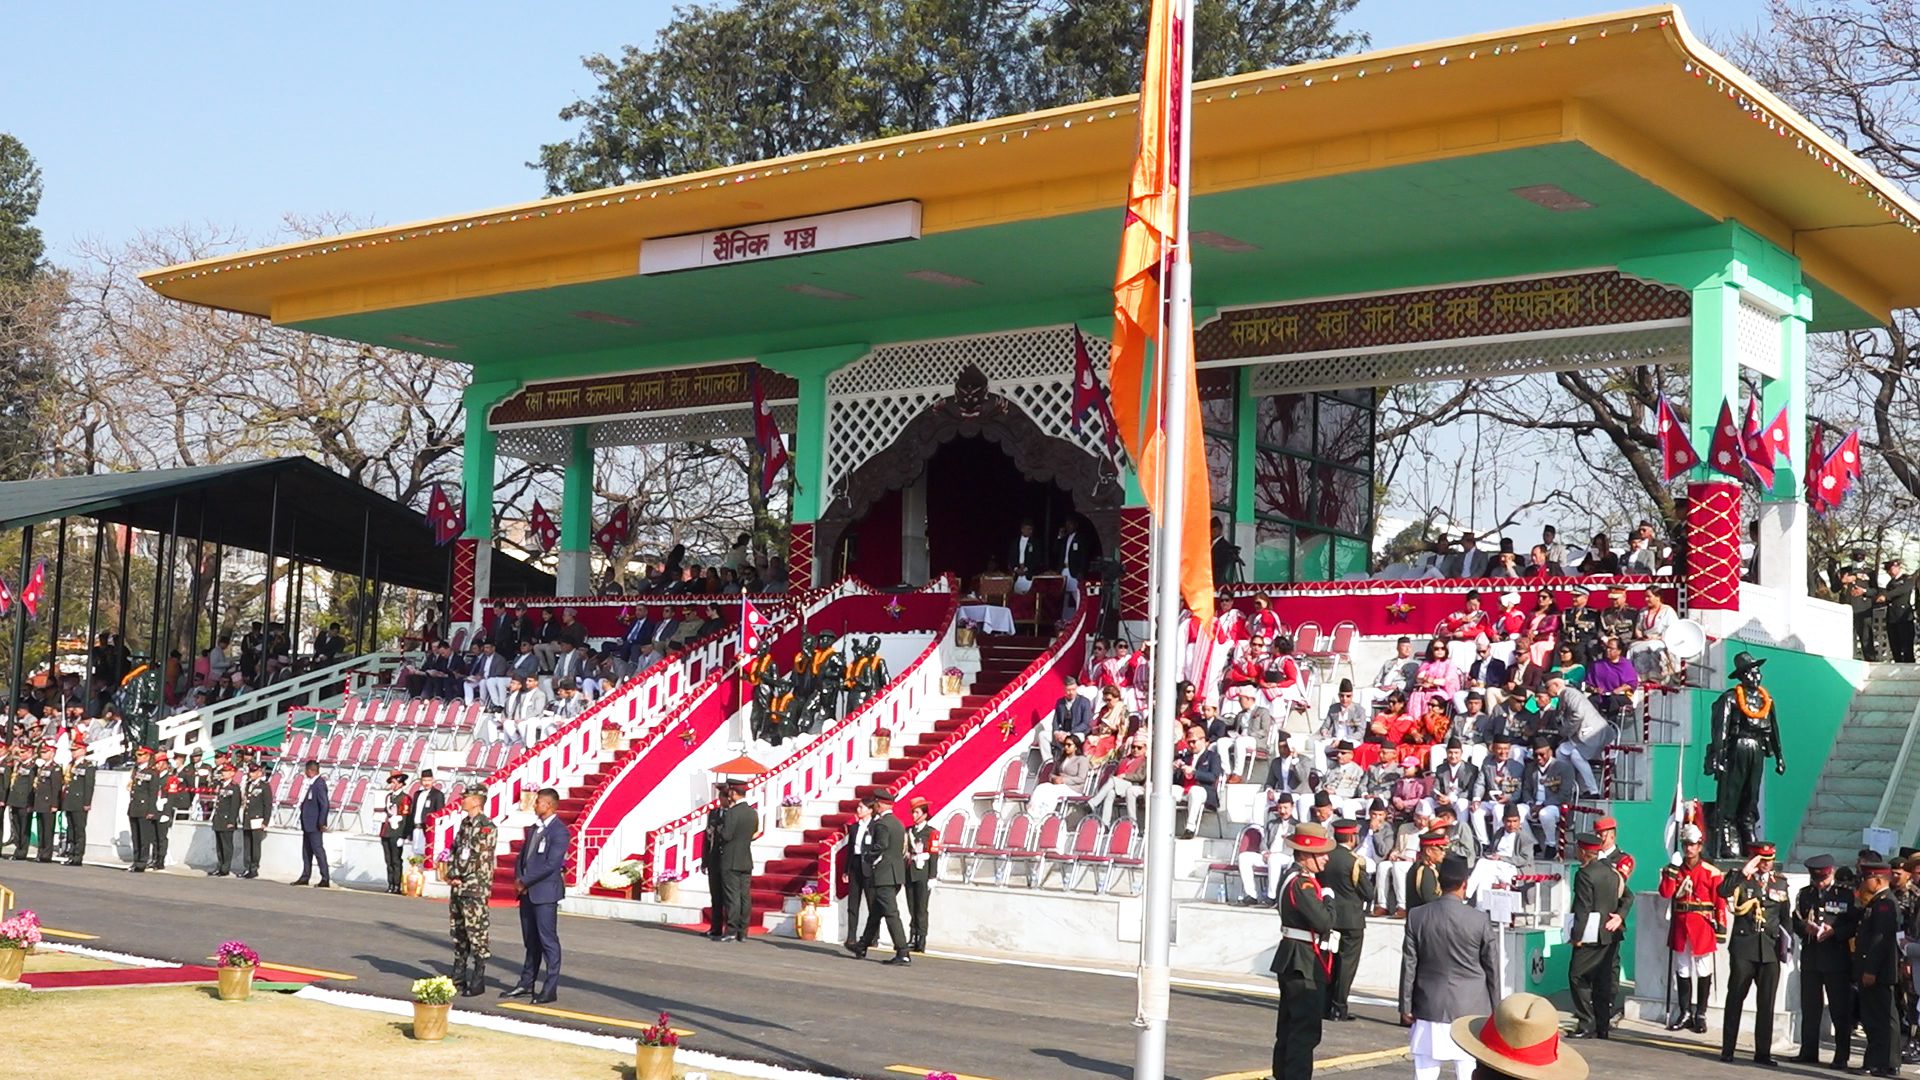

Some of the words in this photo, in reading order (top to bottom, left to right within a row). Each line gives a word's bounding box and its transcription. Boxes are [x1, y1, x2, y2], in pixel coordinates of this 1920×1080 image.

[713, 229, 770, 261] सैनिक
[1315, 309, 1352, 339] सदा
[547, 387, 581, 409] सम्मान
[586, 384, 625, 407] कल्याण
[1531, 956, 1544, 975] A-3
